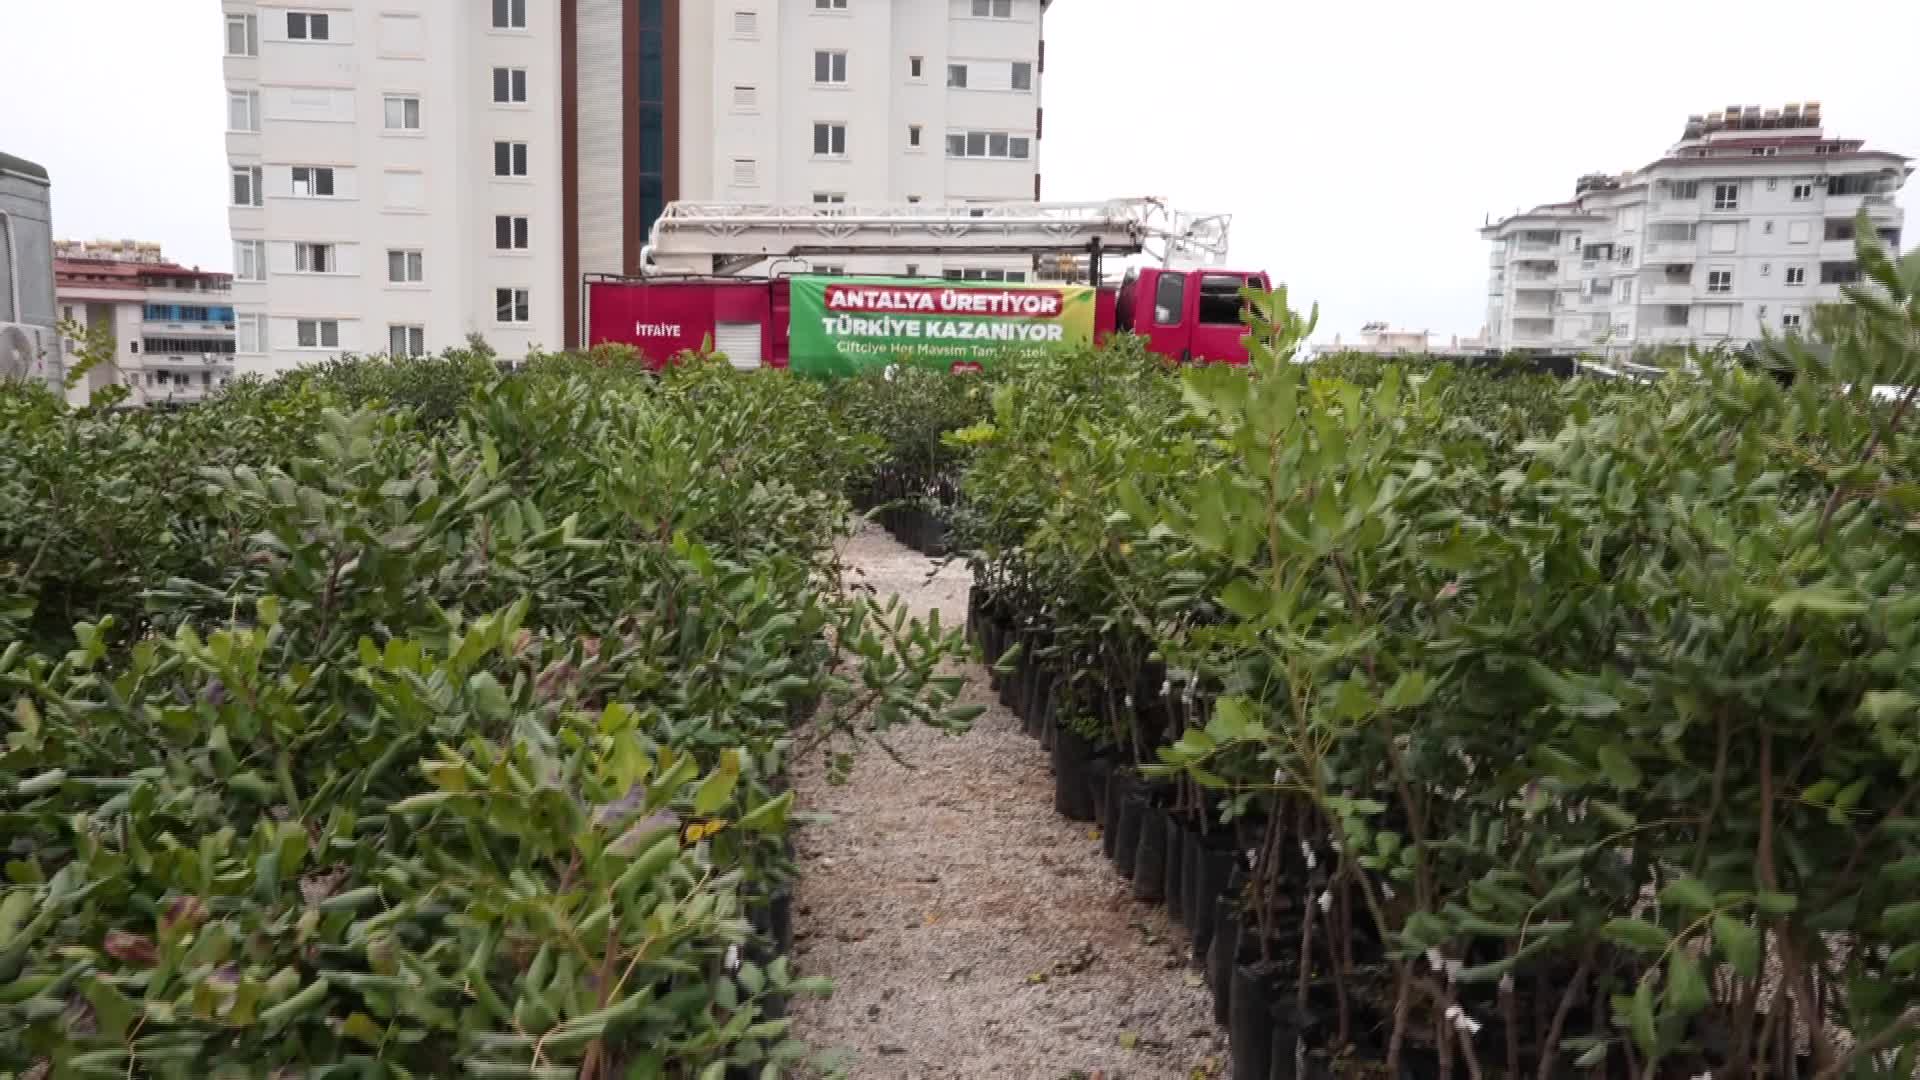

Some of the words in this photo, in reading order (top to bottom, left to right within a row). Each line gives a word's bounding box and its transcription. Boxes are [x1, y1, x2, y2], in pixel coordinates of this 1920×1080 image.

[829, 289, 935, 310] ANTALYA
[940, 289, 1057, 312] ÜRETİYOR
[636, 320, 681, 337] İTFAİYE
[822, 314, 920, 337] TÜRKİYE
[926, 321, 1063, 341] KAZANIYOR
[890, 343, 914, 353] Her
